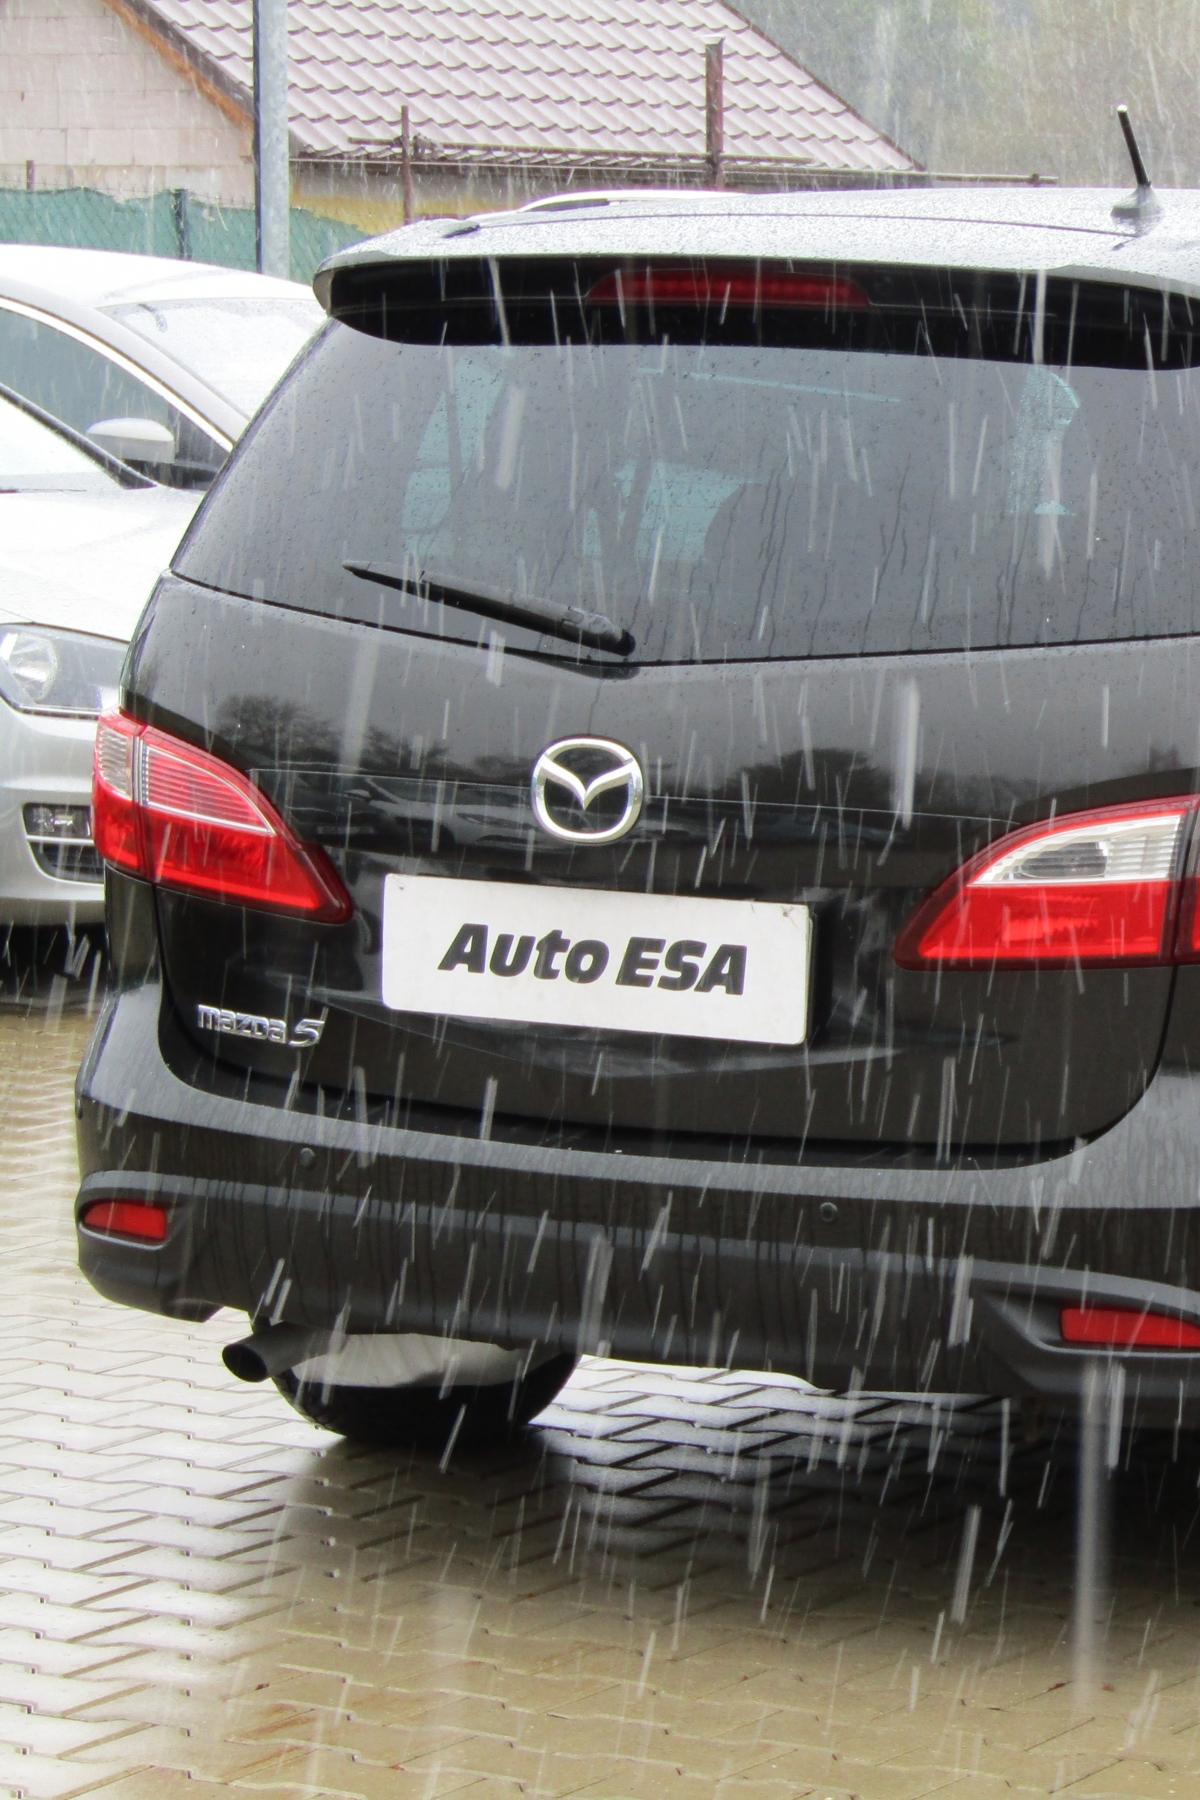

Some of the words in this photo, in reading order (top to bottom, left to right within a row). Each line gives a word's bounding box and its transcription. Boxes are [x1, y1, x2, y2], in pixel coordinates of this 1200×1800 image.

[437, 923, 609, 984] Auto
[615, 936, 747, 995] ESA
[288, 1018, 325, 1047] 5
